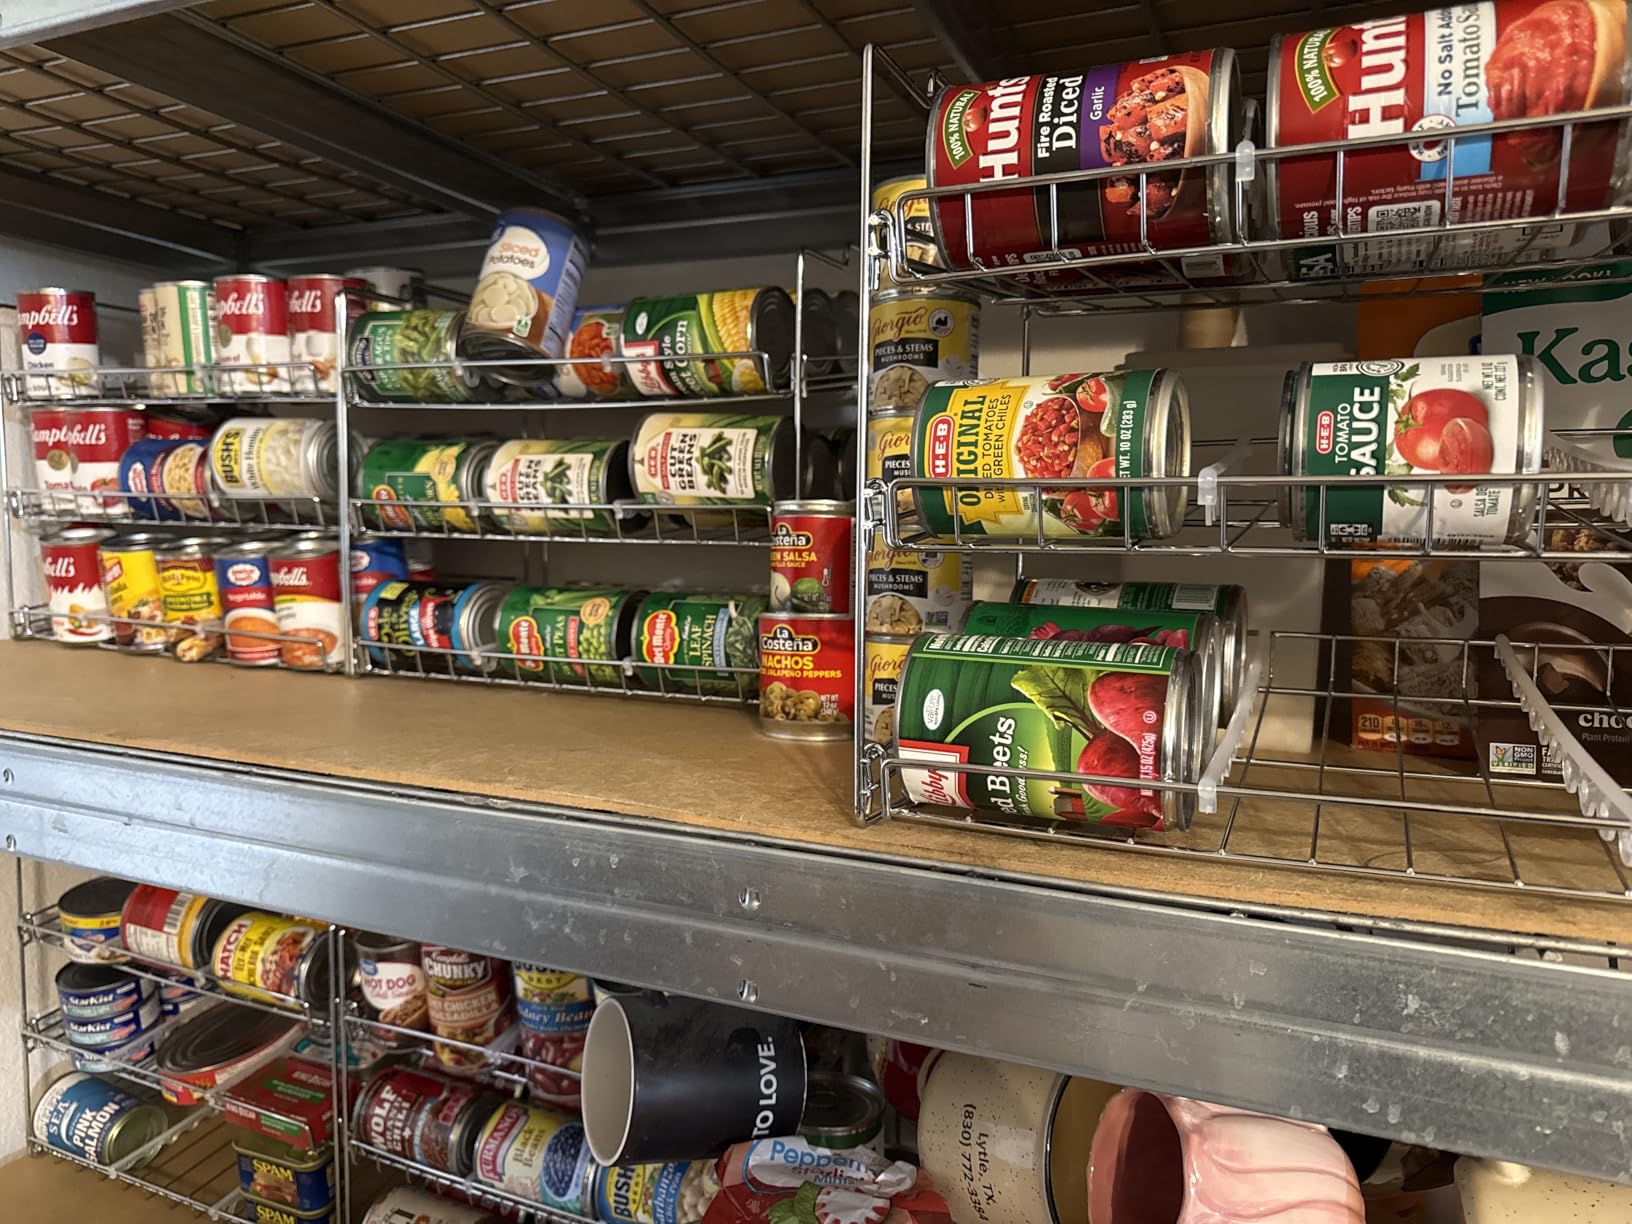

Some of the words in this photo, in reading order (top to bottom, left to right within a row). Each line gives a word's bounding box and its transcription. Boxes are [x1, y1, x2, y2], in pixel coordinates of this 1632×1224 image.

[1437, 32, 1453, 64] Salt
[1304, 70, 1328, 102] 100%
[1437, 69, 1453, 96] No
[1454, 24, 1480, 117] Tomato
[948, 91, 974, 133] NATURAL
[1039, 77, 1058, 122] Roasted
[1052, 75, 1083, 151] Diced
[1089, 86, 1105, 121] Garlic
[954, 132, 966, 160] 100%
[1038, 125, 1050, 158] Fire
[914, 222, 932, 232] STE
[880, 352, 924, 363] MUSHROOMS
[896, 344, 904, 353] &
[905, 343, 934, 353] STEMS
[982, 397, 999, 459] TOMATOES
[996, 394, 1012, 431] CHILES
[1120, 438, 1131, 450] 10
[1122, 427, 1133, 439] OZ
[1335, 403, 1351, 463] TOMATO
[220, 431, 241, 484] BUSH'S
[669, 443, 678, 478] CUT
[677, 433, 688, 490] GREEN
[686, 433, 698, 490] BEANS
[956, 394, 988, 507] OIGINAL
[994, 434, 1004, 478] GREEN
[1118, 453, 1130, 468] WT.
[518, 470, 526, 501] CUT
[981, 461, 995, 500] DIED
[1473, 497, 1486, 517] SALSA
[1486, 490, 1500, 516] TOMATE
[777, 526, 787, 535] La
[783, 551, 818, 562] SALSA
[873, 582, 914, 591] MUSHROOMS
[896, 574, 923, 583] STEMS
[409, 607, 424, 645] LARGE
[553, 615, 566, 644] PEAS
[652, 613, 667, 646] Monte
[688, 624, 702, 657] LEAF
[702, 614, 717, 666] SPINACH
[776, 627, 789, 639] La
[653, 647, 664, 663] Del
[761, 637, 813, 651] Costeña
[761, 654, 814, 669] NACHOS
[803, 669, 842, 679] PEPPERS
[1361, 716, 1380, 728] 210
[1582, 733, 1602, 741] Plant
[1602, 733, 1630, 742] Protein
[1140, 733, 1155, 755] (425g)
[1491, 761, 1534, 769] VERIFIED
[218, 922, 248, 982] HATCH
[364, 977, 383, 990] HOT
[385, 973, 417, 990] DOG
[424, 957, 487, 981] CHUNKY
[527, 974, 563, 985] BEST
[68, 992, 114, 1006] StarKist
[443, 991, 498, 1012] CHICKEN
[69, 1022, 111, 1034] StarKist
[757, 1035, 778, 1106] LOVE.
[49, 1093, 69, 1136] SEA
[72, 1107, 98, 1148] PINK
[371, 1084, 399, 1151] WOLF
[394, 1100, 411, 1152] CHILI
[752, 1109, 775, 1138] TO
[958, 1103, 977, 1147] (830)
[84, 1102, 121, 1162] SALMON
[480, 1107, 529, 1182] FURMANO'S
[513, 1125, 535, 1163] Black
[522, 1127, 547, 1168] Beans
[252, 1159, 294, 1181] SPAM
[976, 1132, 990, 1177] Lytle,
[631, 1172, 641, 1205] BEST
[960, 1152, 990, 1222] 772-3384
[982, 1183, 998, 1206] TX,
[256, 1204, 295, 1224] SPAM
